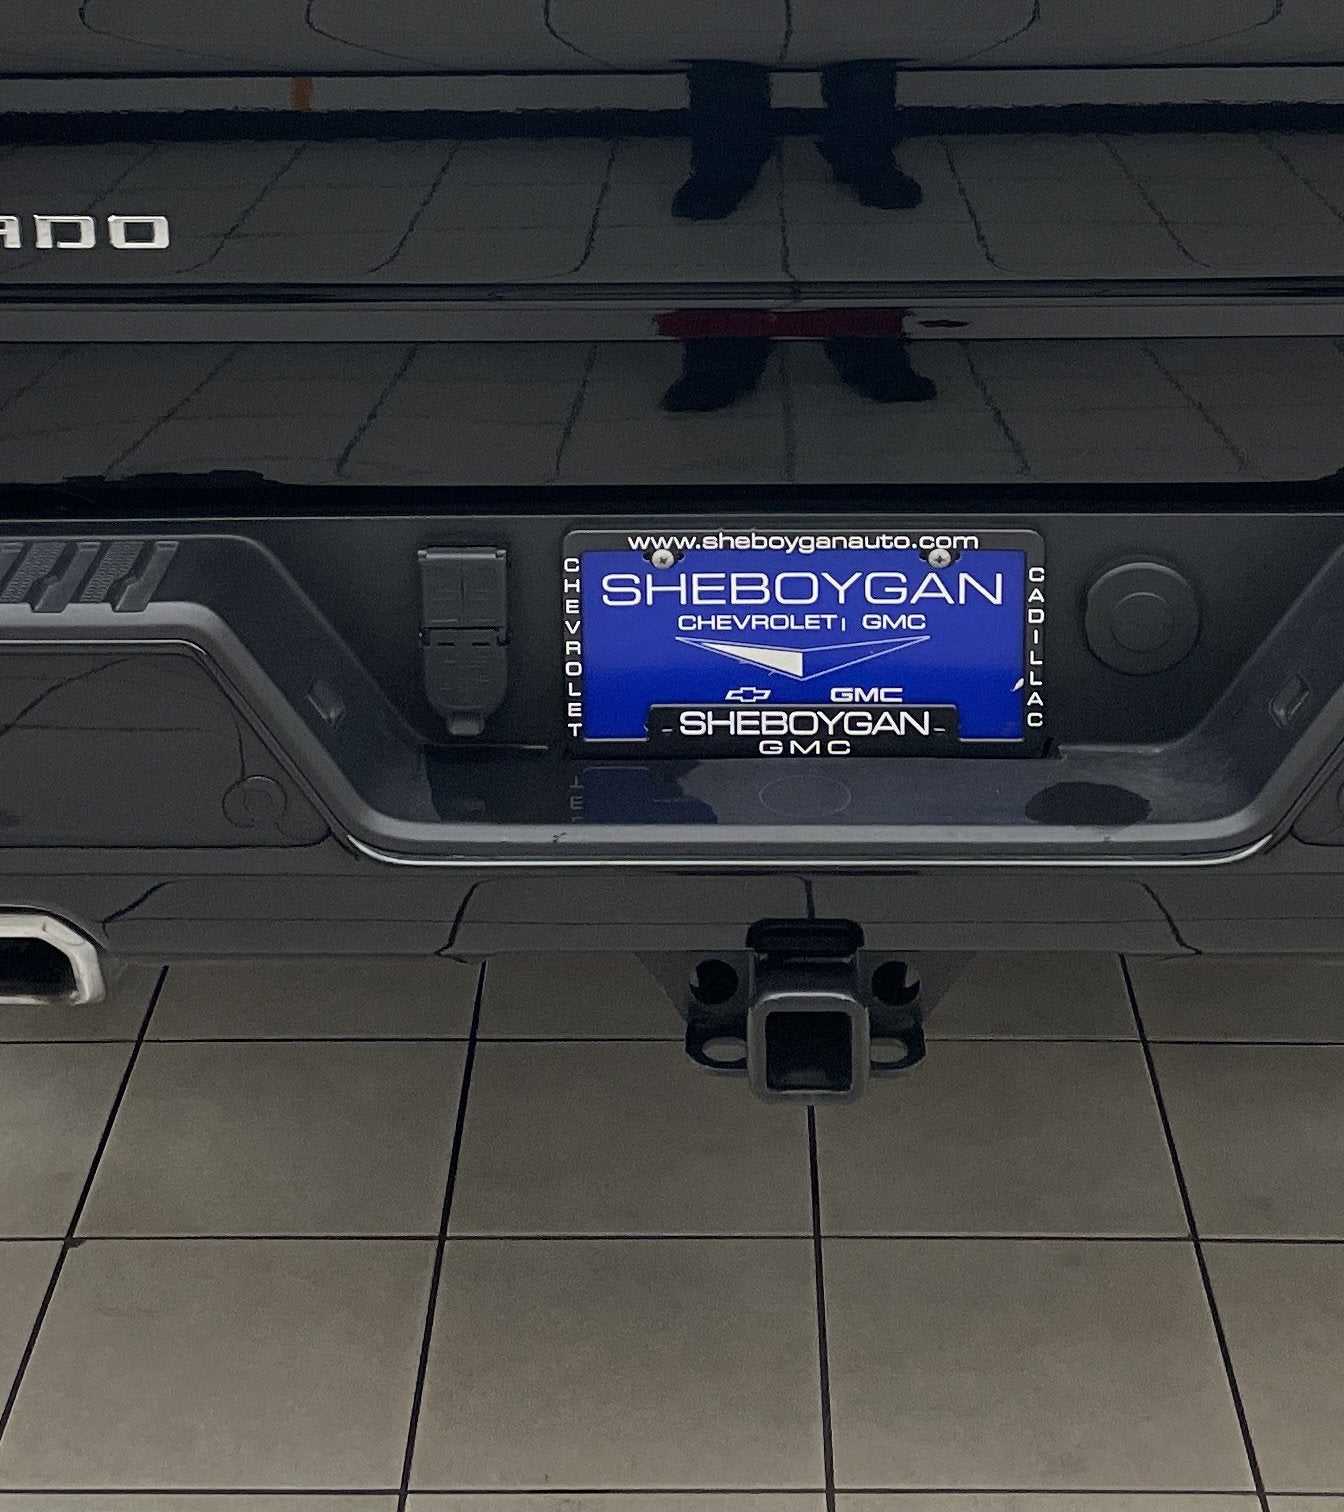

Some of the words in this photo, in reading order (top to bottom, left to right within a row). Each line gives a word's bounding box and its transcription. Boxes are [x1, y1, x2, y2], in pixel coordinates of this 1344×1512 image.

[627, 532, 979, 554] www.sheboyganauto.com
[601, 571, 1003, 606] SHEBOYGAN
[677, 614, 838, 631] CHEVROLET
[861, 613, 926, 630] GMC
[564, 557, 583, 737] CHEVROLET
[1026, 566, 1045, 728] CADILLAC
[830, 687, 903, 703] GMC
[679, 710, 930, 736] SHEBOYGAN
[758, 739, 851, 755] GMC
